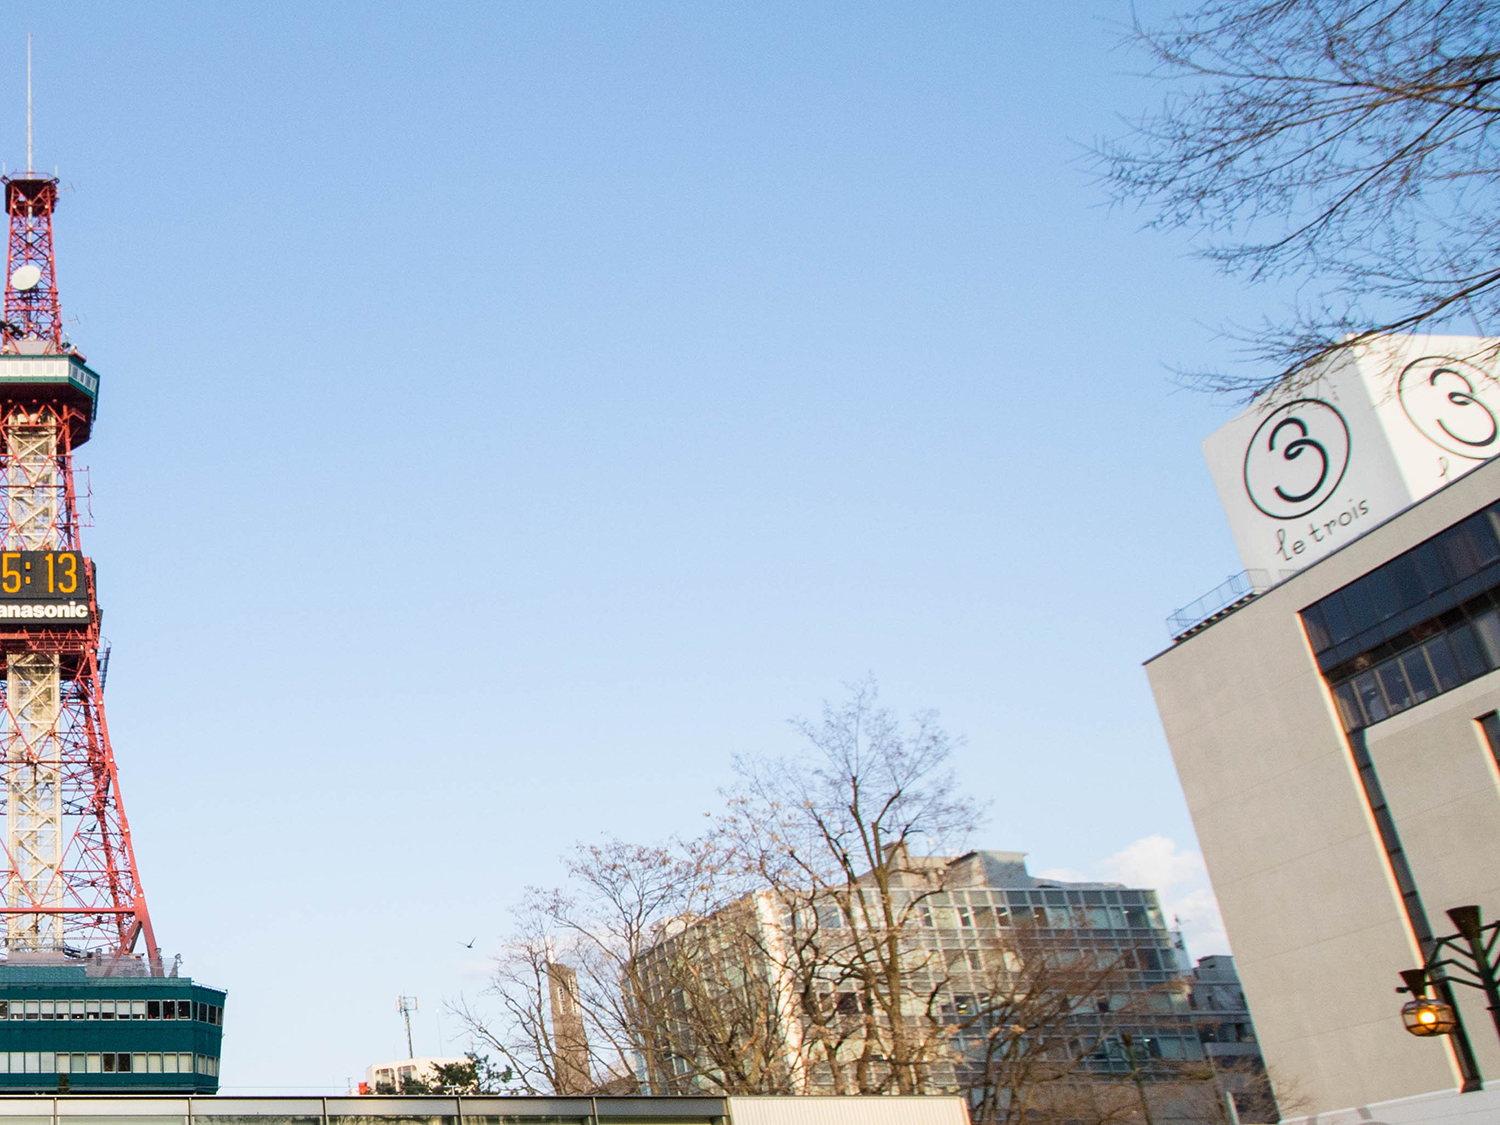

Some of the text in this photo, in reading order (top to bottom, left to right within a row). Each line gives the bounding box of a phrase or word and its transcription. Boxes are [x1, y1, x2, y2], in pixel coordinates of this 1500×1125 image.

[1268, 417, 1329, 502] 3
[1276, 498, 1370, 561] le trois
[2, 552, 77, 593] 5:13
